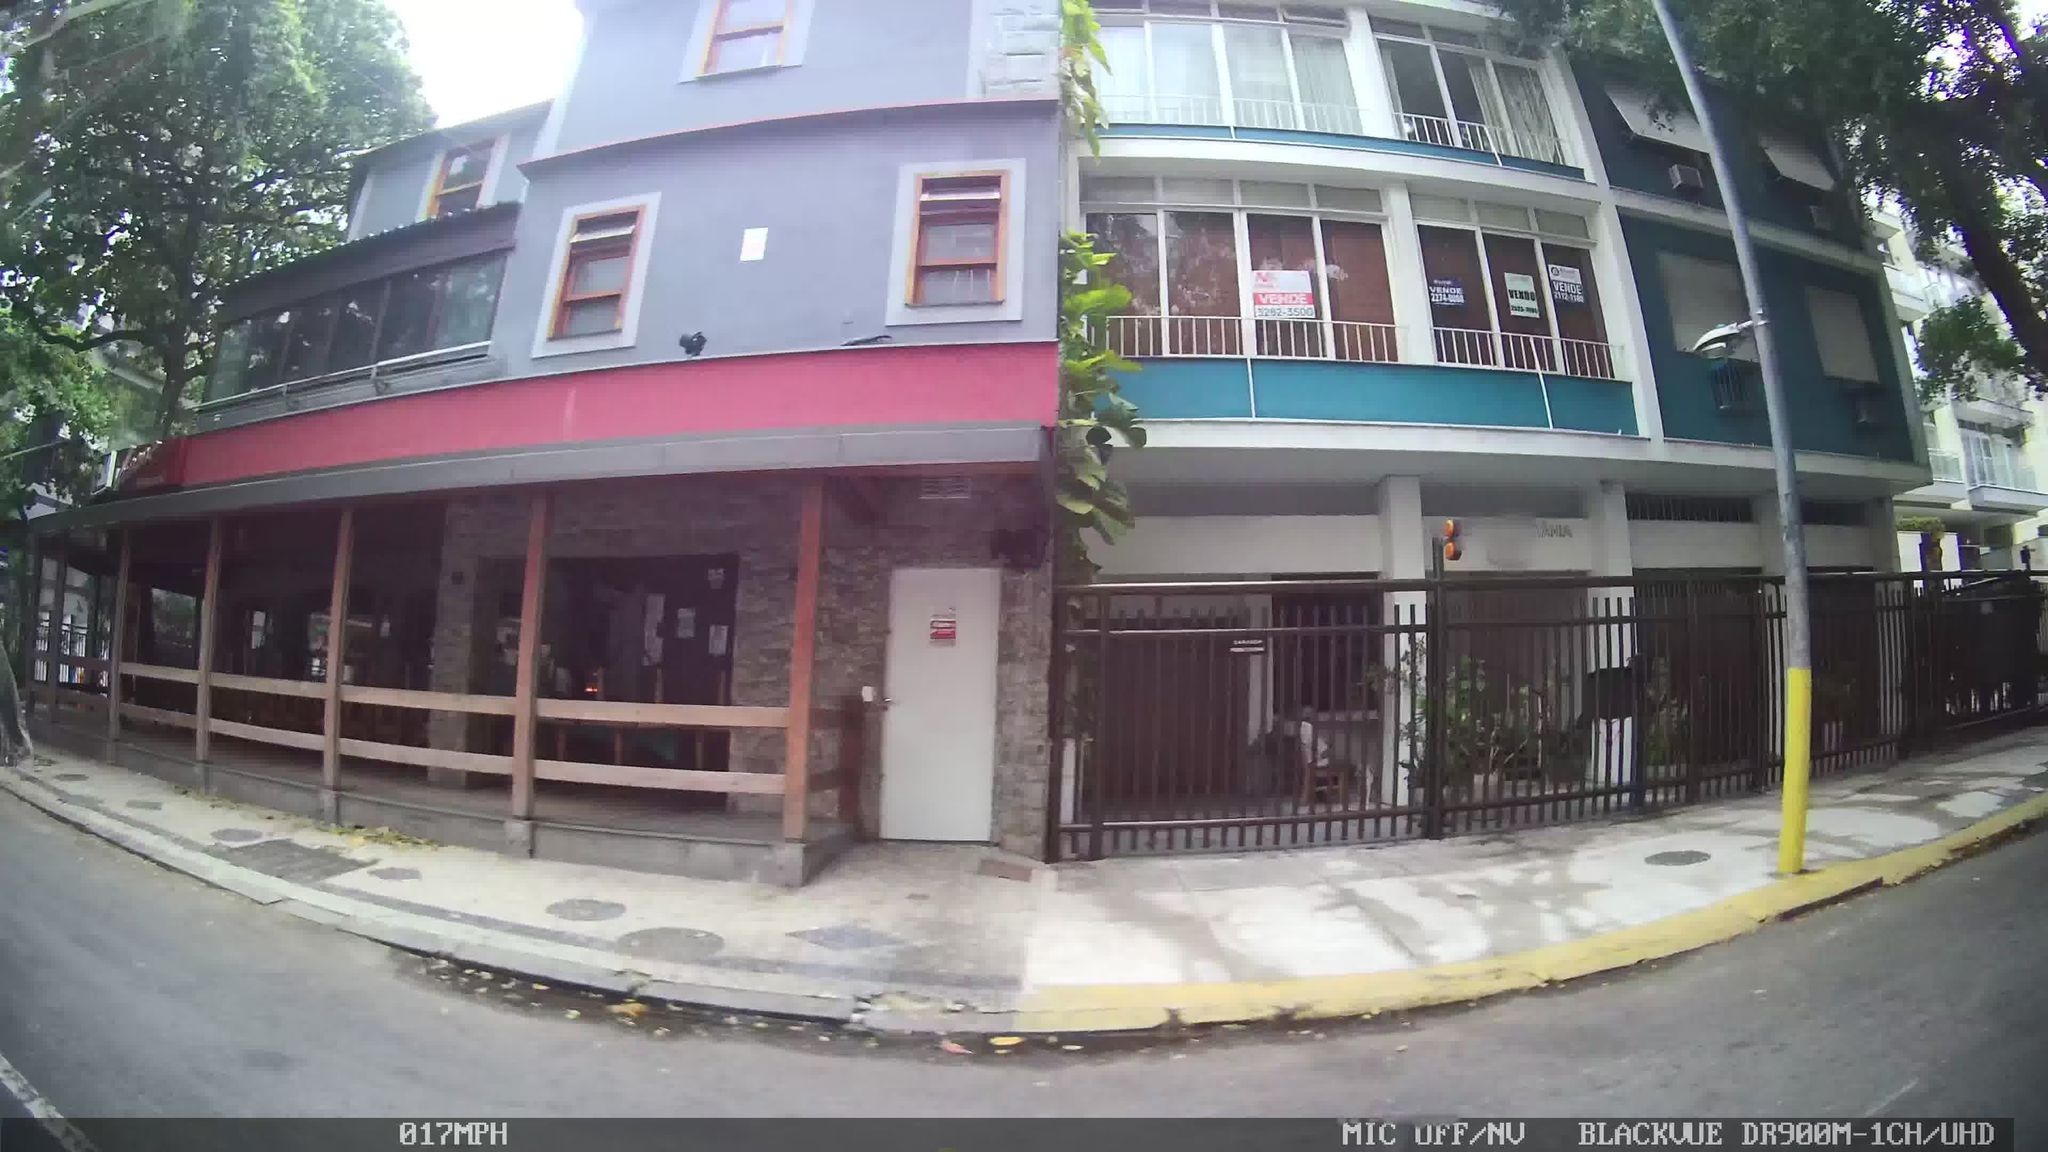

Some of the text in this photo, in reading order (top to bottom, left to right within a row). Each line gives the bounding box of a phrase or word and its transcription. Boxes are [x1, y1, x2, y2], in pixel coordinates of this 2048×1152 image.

[1429, 286, 1463, 295] VENDE
[1552, 281, 1582, 295] VENDE
[1257, 293, 1308, 305] VENDE
